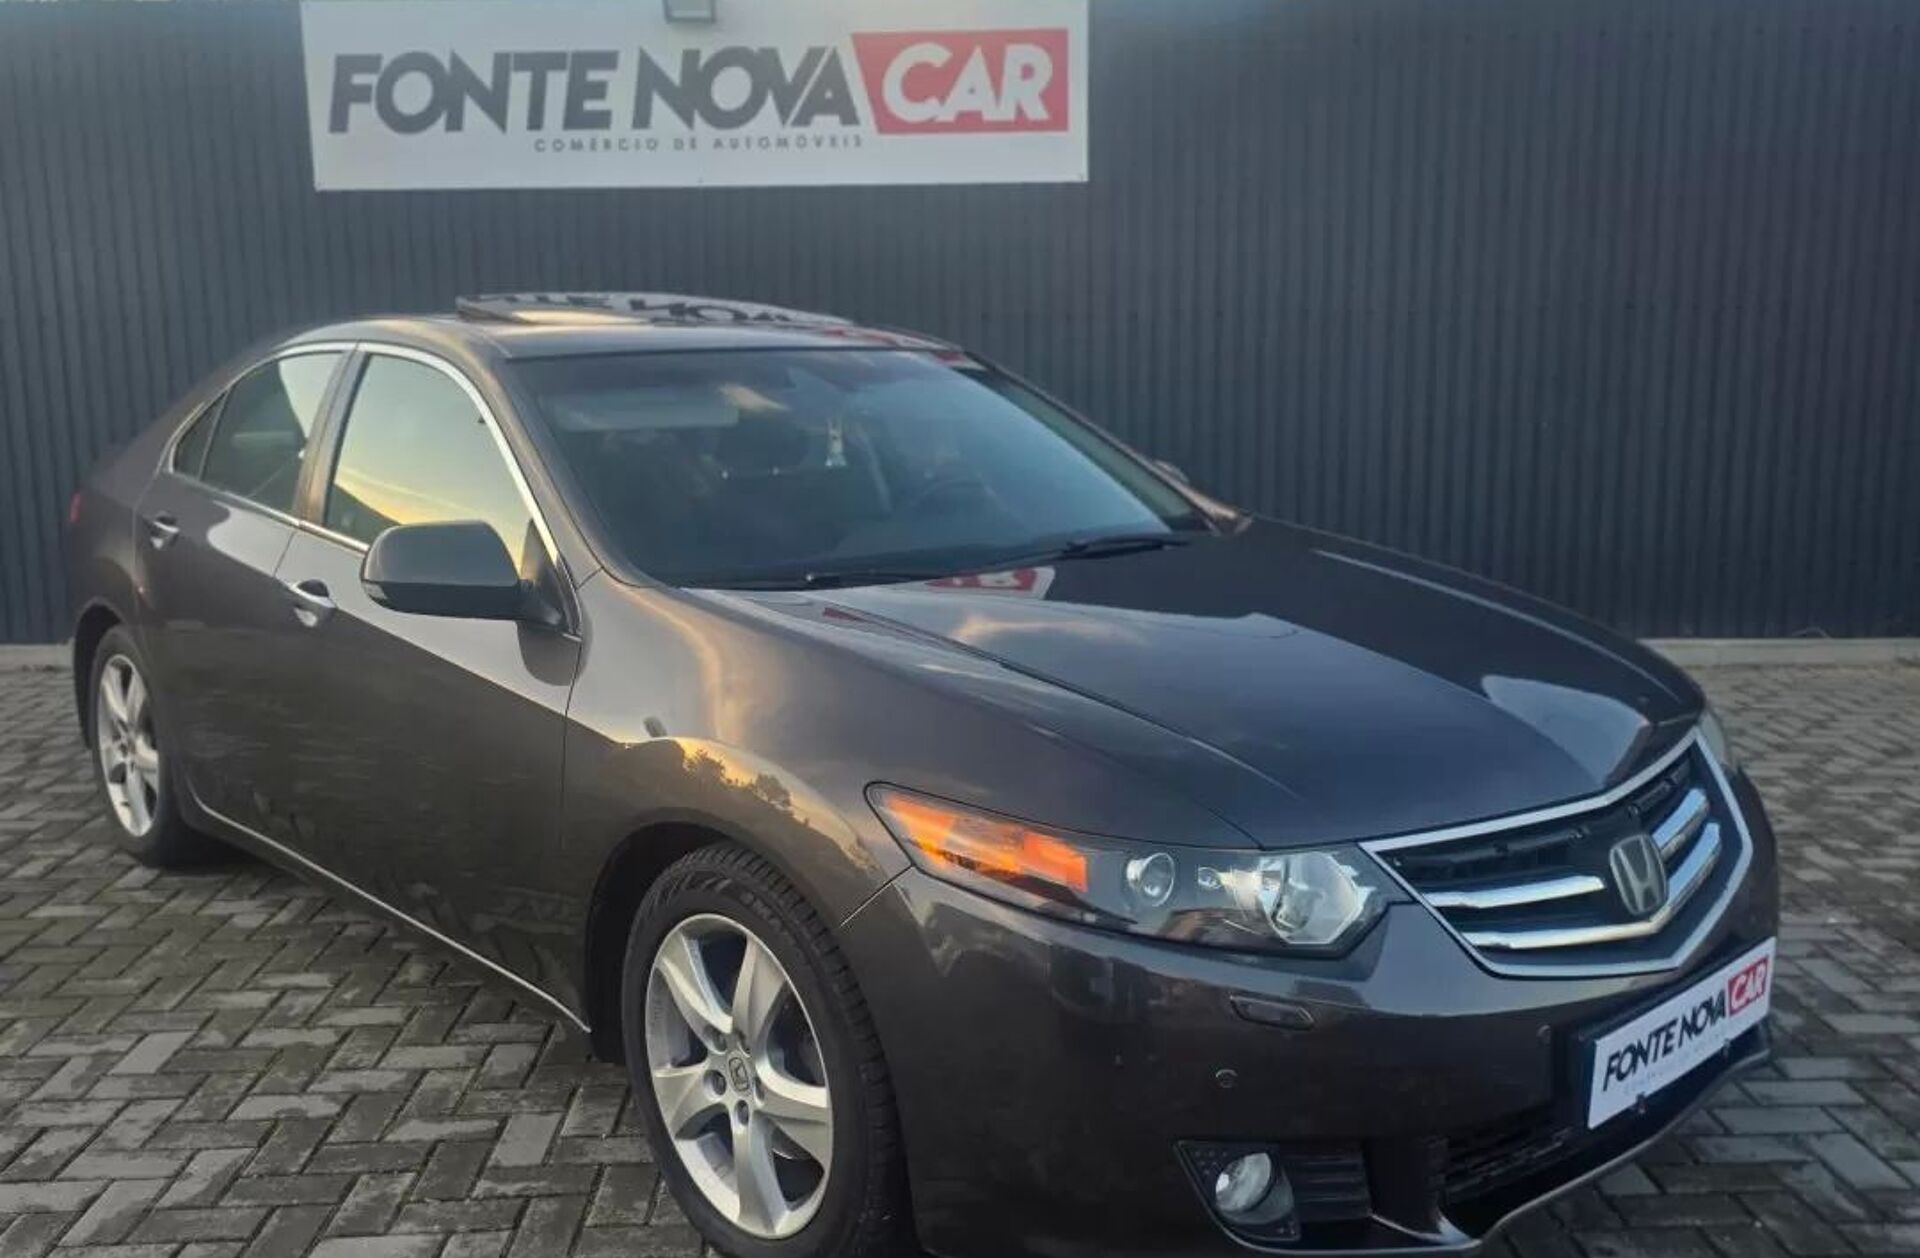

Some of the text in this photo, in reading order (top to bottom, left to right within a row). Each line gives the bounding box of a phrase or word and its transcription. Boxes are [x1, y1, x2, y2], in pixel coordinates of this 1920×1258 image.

[329, 42, 1053, 134] FONTE NOVA CAR
[674, 137, 698, 151] DE
[1602, 1018, 1679, 1092] FONTE
[1678, 990, 1726, 1048] NOVA
[1731, 959, 1769, 1014] CAR
